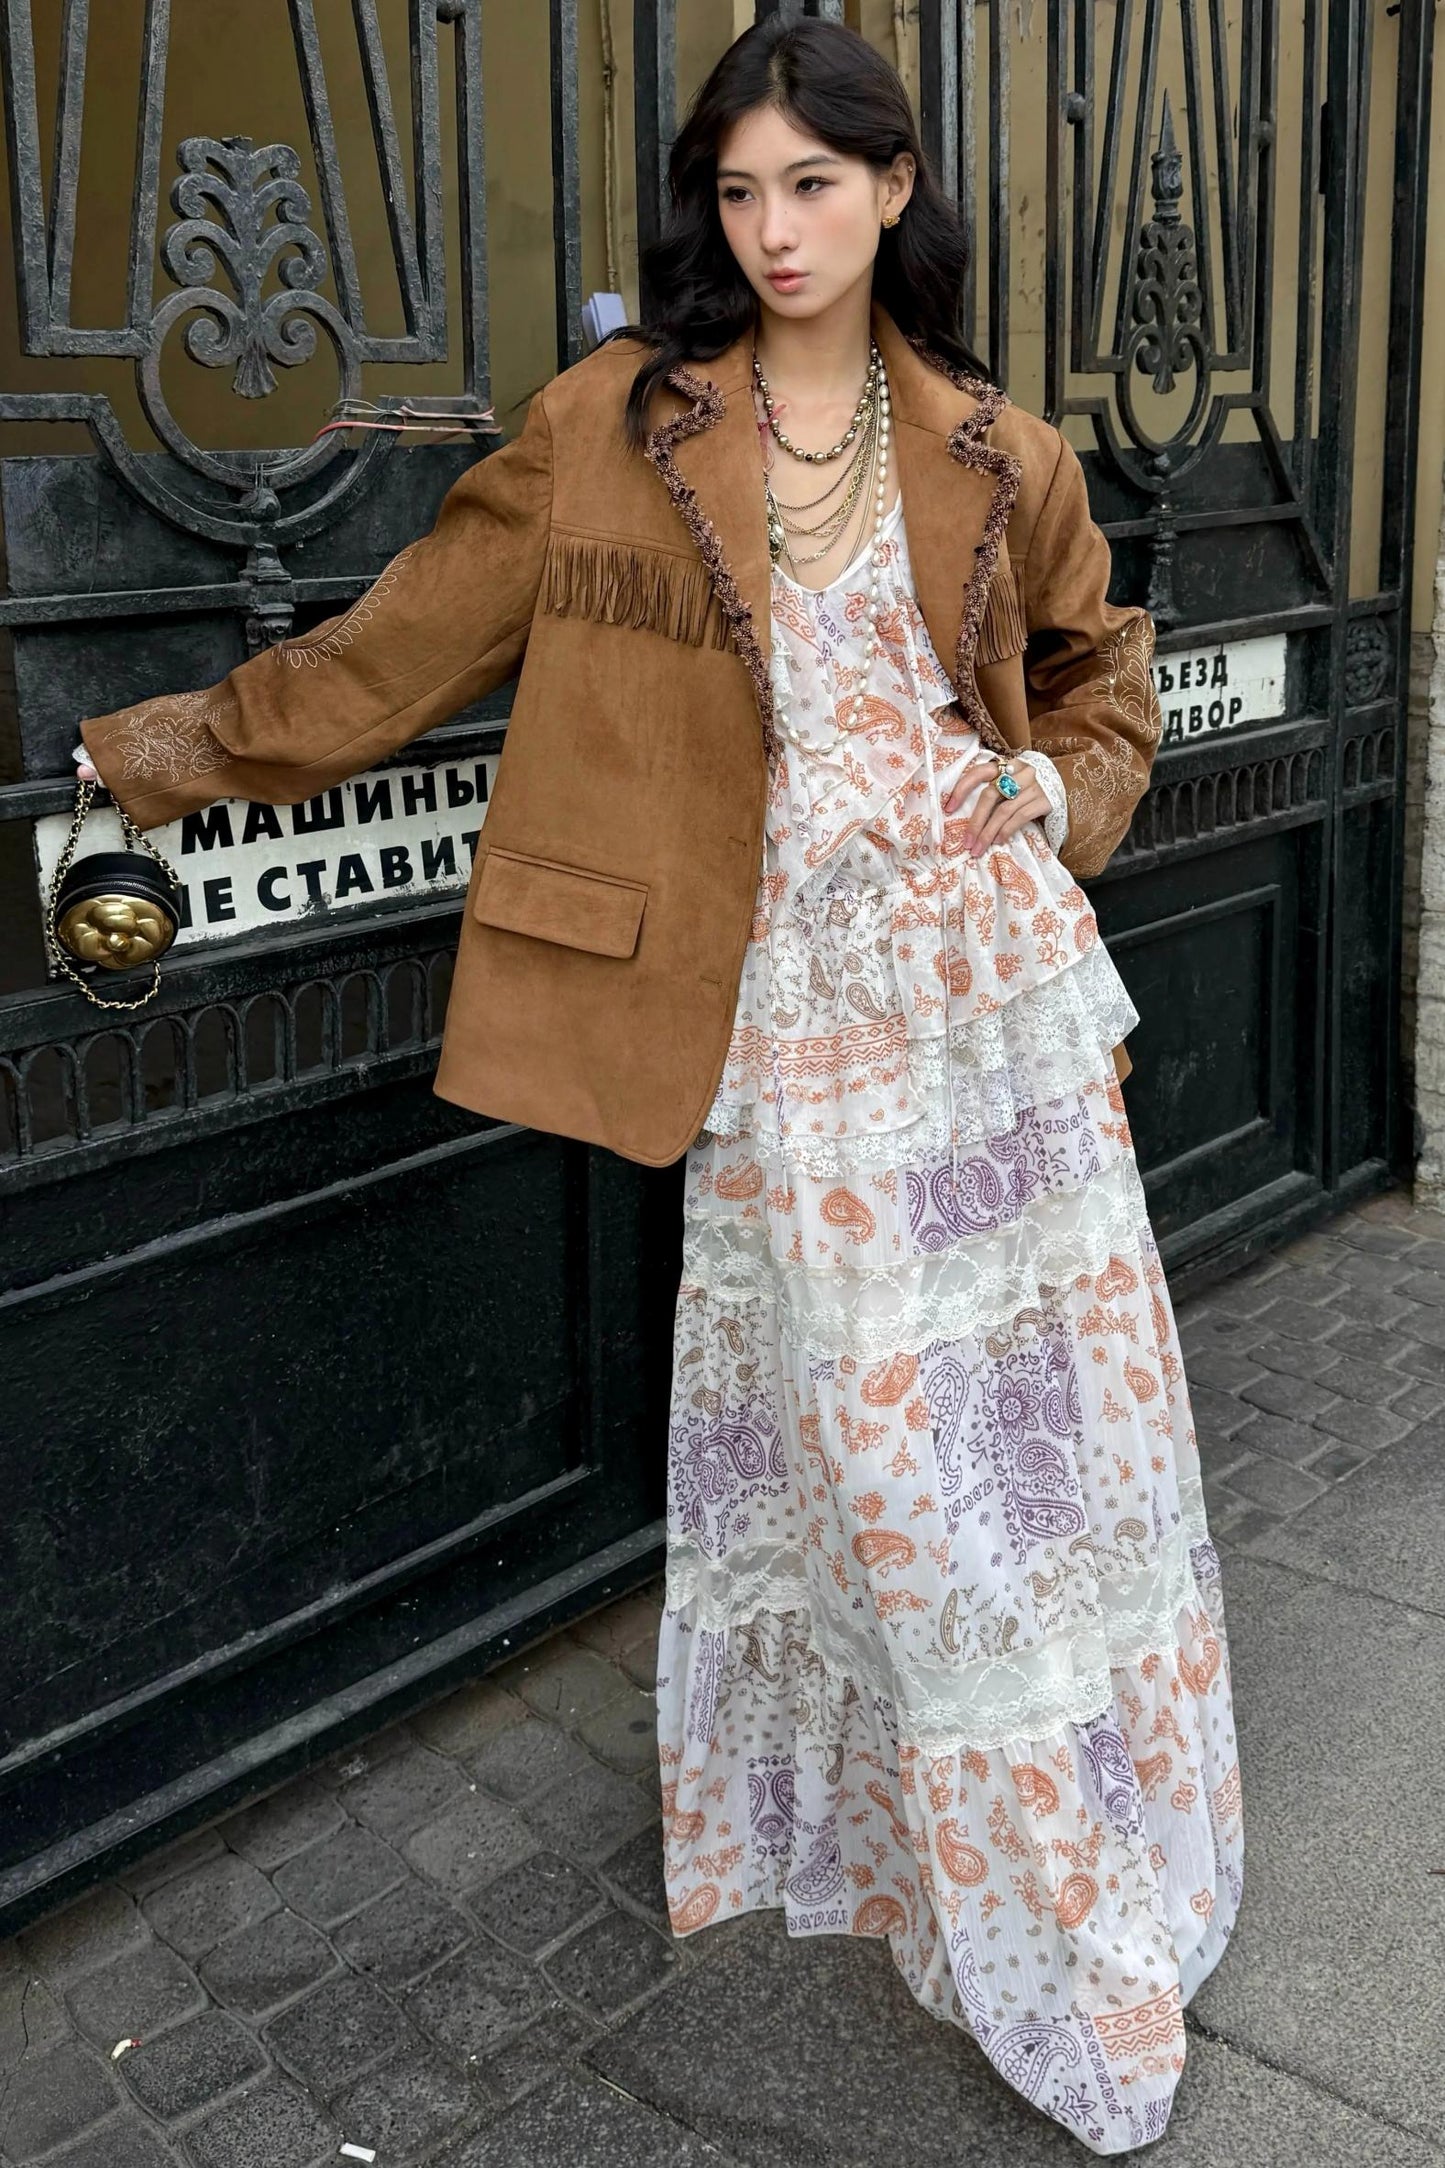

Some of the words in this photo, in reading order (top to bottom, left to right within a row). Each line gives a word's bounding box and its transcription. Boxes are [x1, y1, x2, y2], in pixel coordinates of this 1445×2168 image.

[1149, 654, 1228, 694] ЪЕЗД
[1164, 697, 1242, 741] ДВОР
[181, 763, 489, 855] МАШИНЫ
